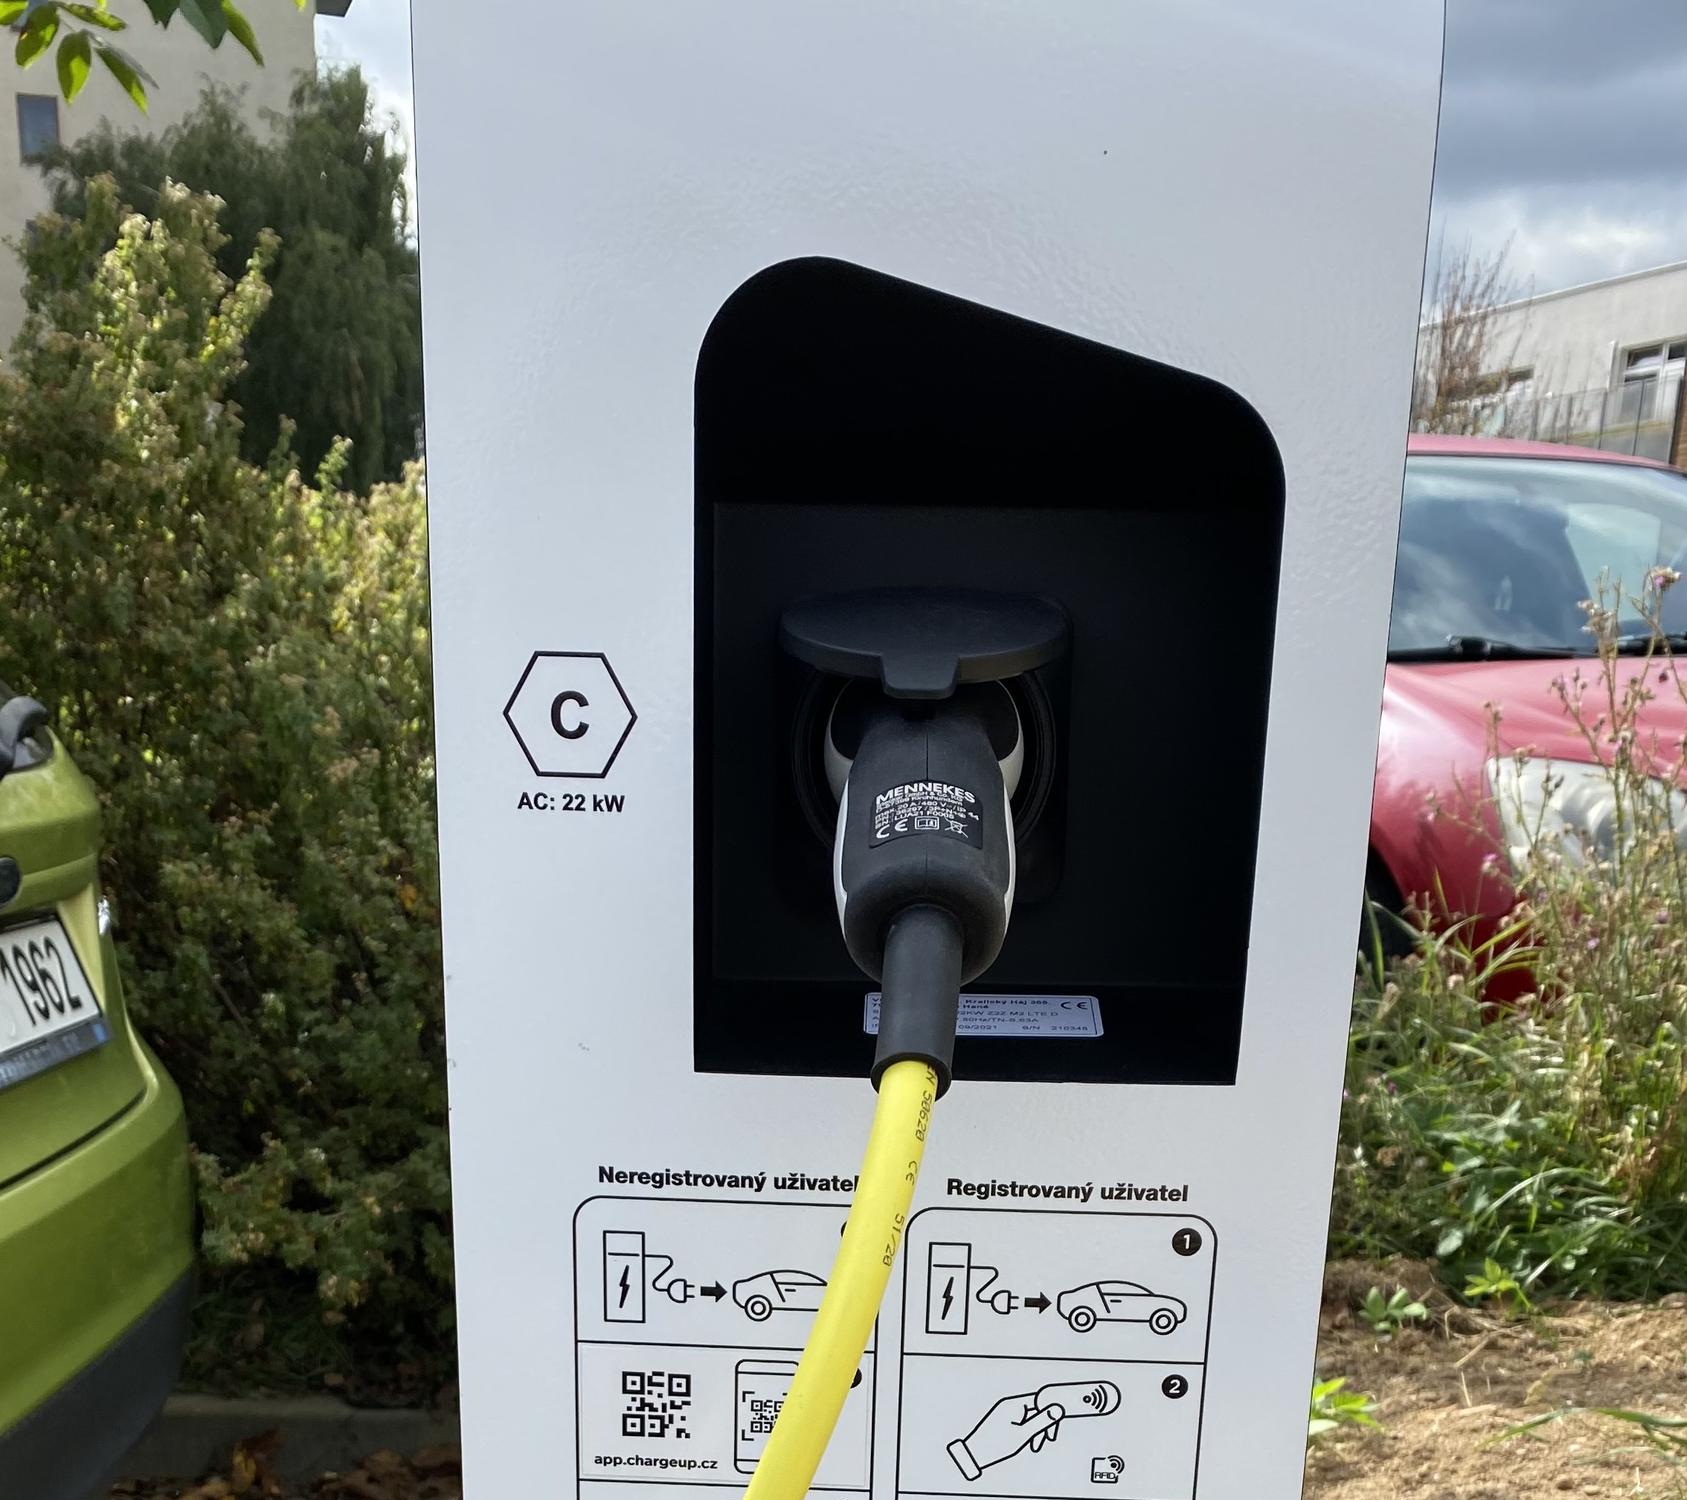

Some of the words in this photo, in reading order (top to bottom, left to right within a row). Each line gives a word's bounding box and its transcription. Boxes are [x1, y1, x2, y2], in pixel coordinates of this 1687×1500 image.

[551, 691, 589, 740] C
[517, 792, 555, 810] AC:
[562, 793, 586, 812] 22
[593, 794, 625, 813] kW
[876, 782, 976, 804] MENNEKES
[599, 1166, 767, 1192] Neregistrovaný
[774, 1172, 859, 1192] uživatel
[947, 1178, 1094, 1203] Registrovaný
[1101, 1183, 1188, 1202] uživatel
[594, 1455, 718, 1470] app.chargeup.cz
